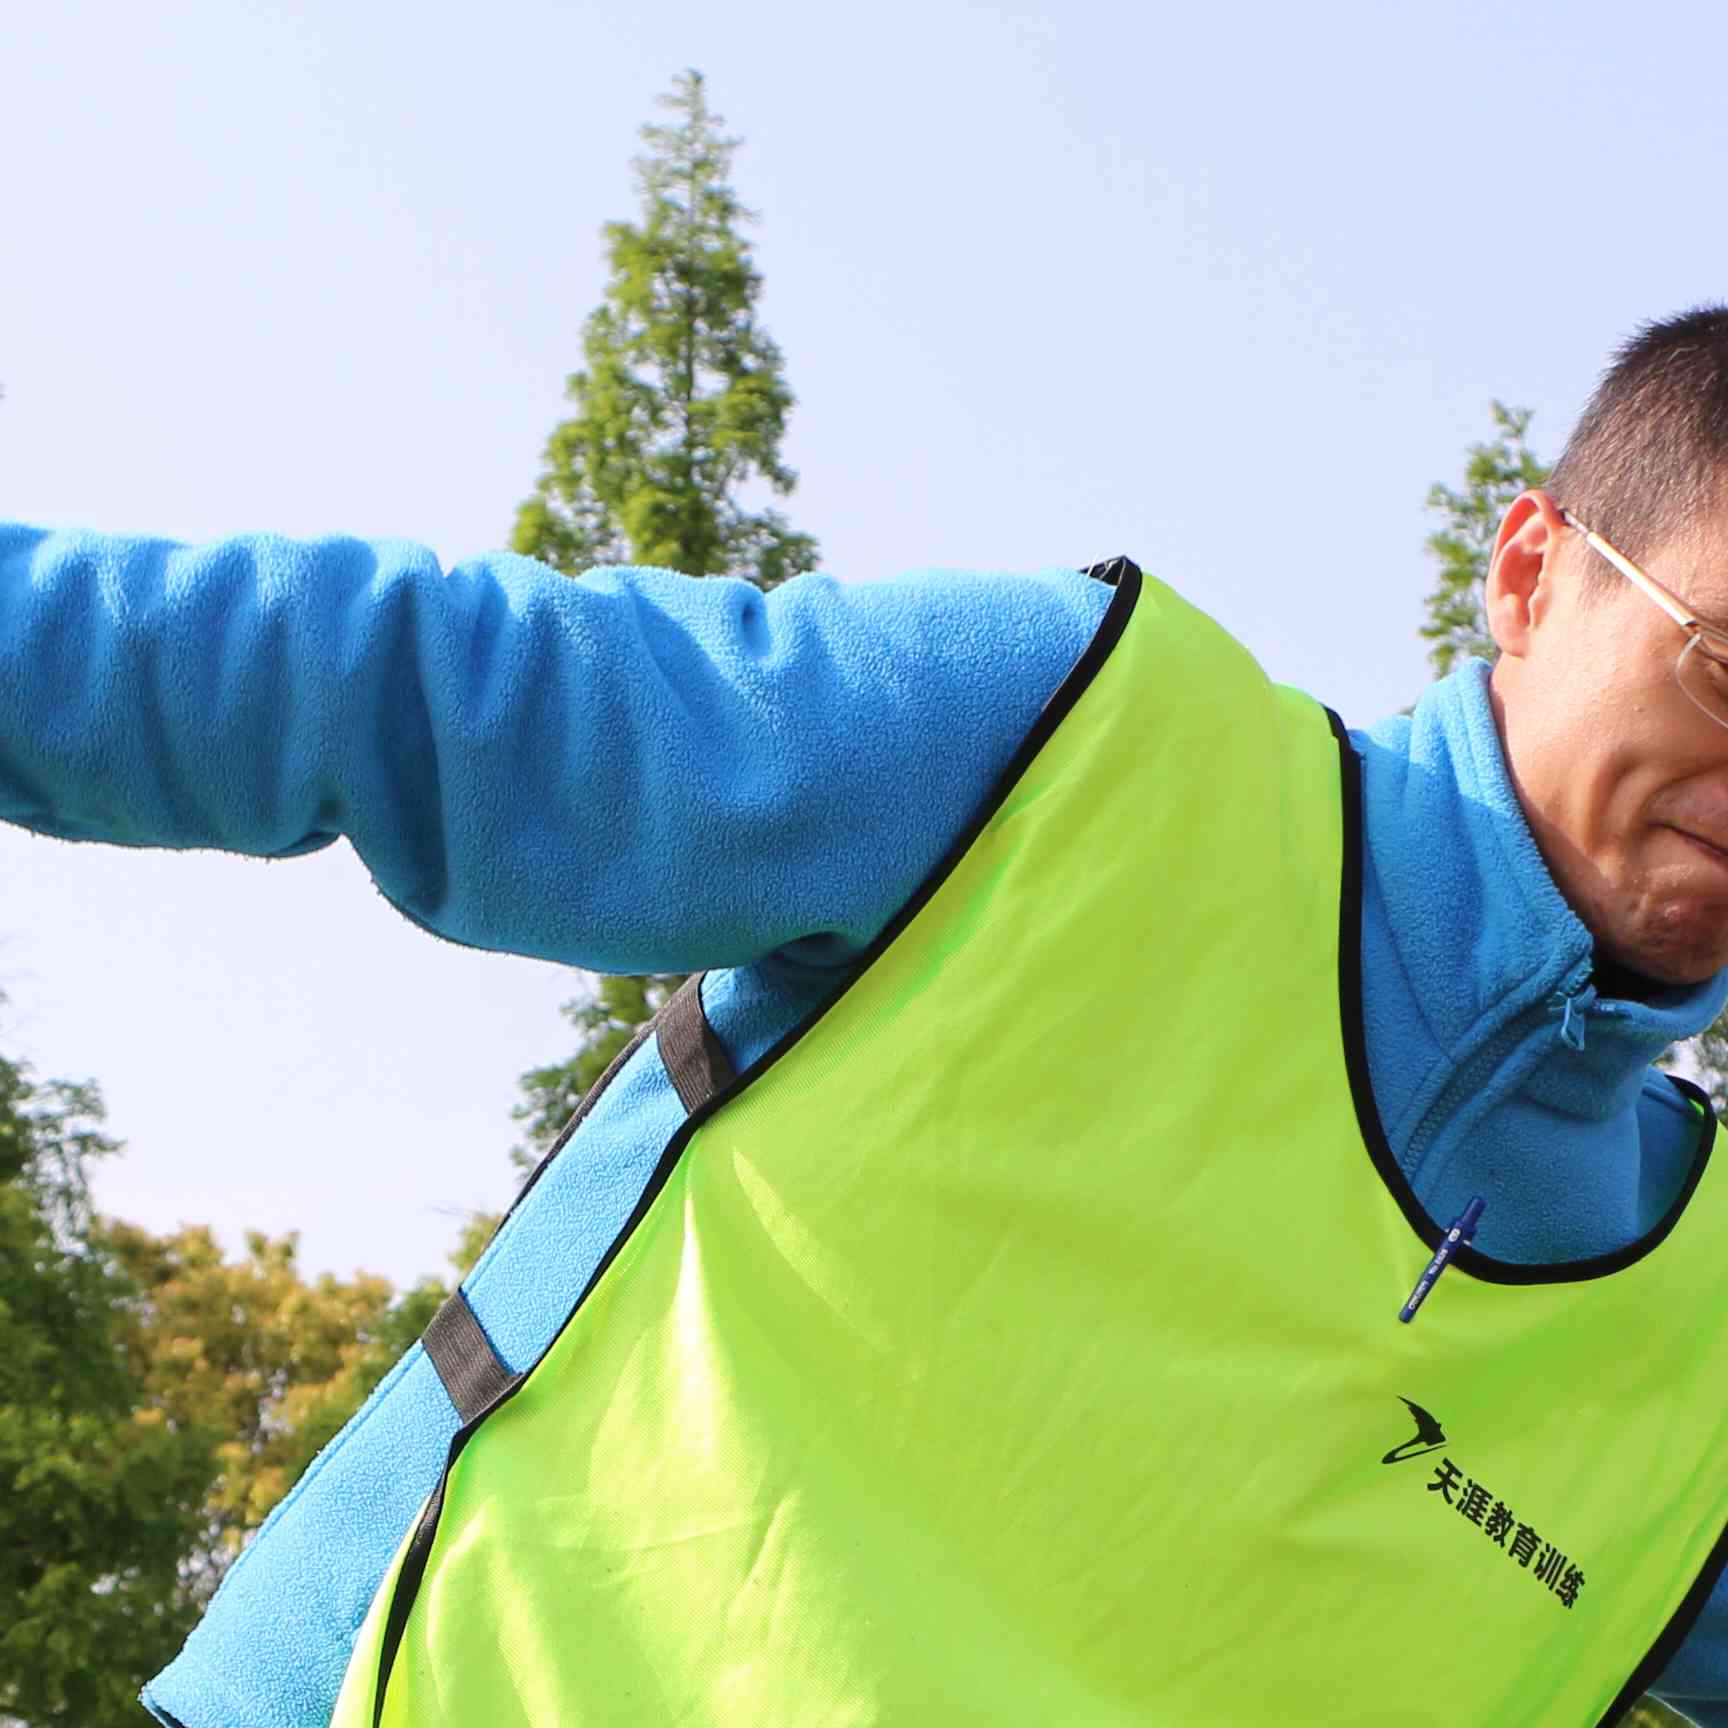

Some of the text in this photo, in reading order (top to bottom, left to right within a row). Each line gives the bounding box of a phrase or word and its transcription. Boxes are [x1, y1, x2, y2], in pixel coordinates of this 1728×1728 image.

[1427, 1457, 1585, 1609] 天涯教育训练
